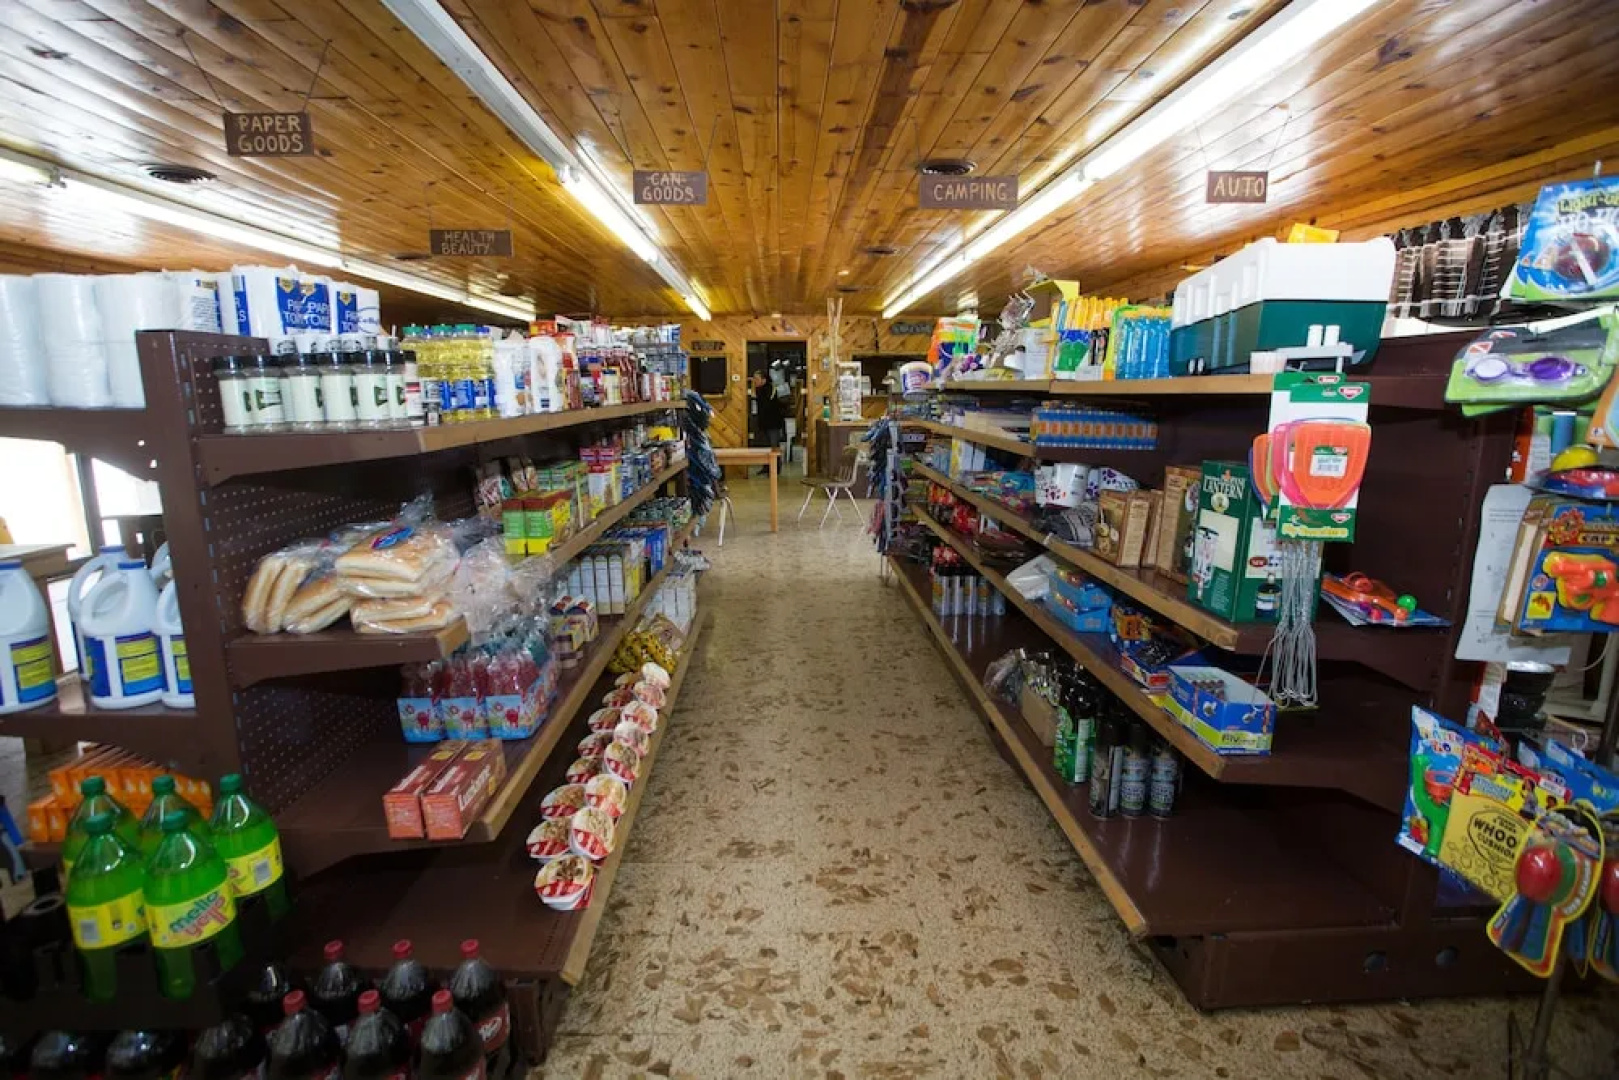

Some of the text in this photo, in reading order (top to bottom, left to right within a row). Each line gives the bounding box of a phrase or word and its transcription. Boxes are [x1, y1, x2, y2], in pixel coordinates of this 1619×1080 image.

[238, 114, 302, 133] PAPER
[237, 133, 304, 153] GOODS
[642, 186, 695, 202] GOODS
[933, 182, 1008, 202] CAMPING
[1212, 175, 1266, 197] AUTO
[443, 231, 495, 243] HEALTH
[440, 243, 491, 255] BEAUTY
